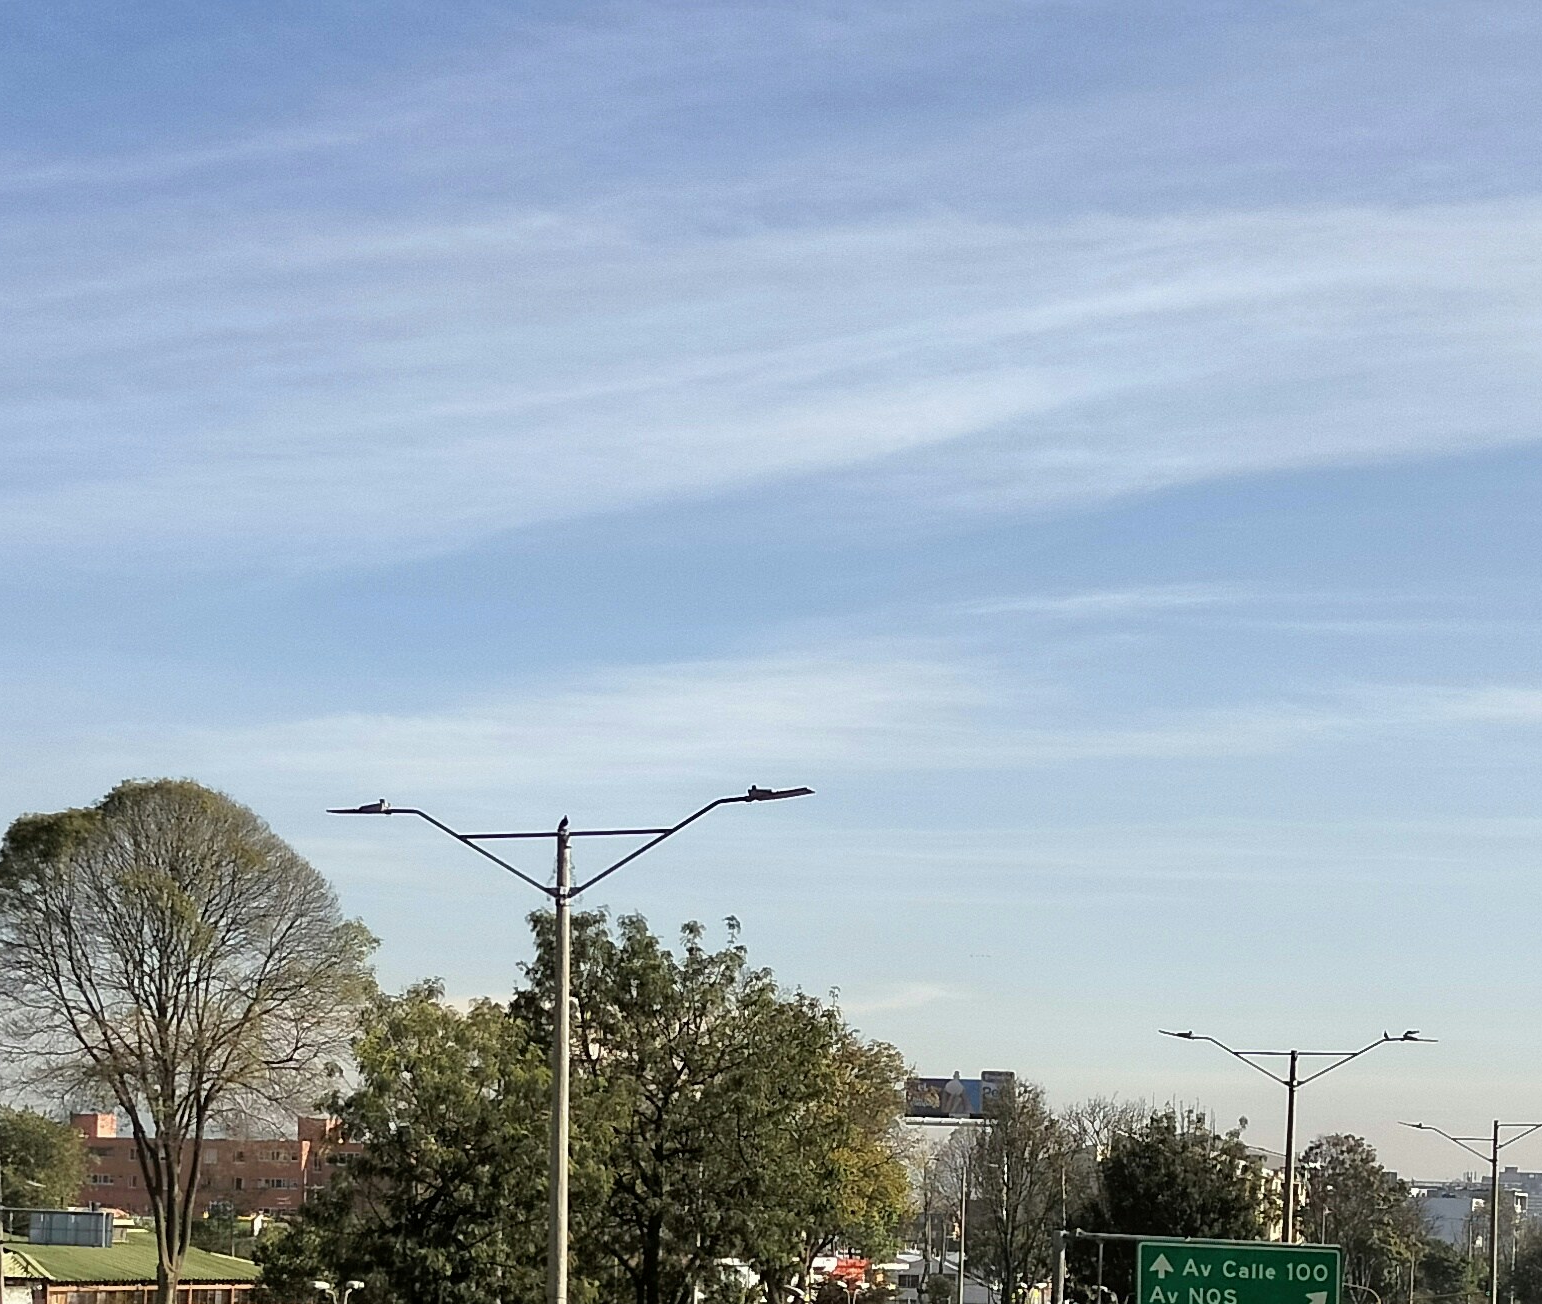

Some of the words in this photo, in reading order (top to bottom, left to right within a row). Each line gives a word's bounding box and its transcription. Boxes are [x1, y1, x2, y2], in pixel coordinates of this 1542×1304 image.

[1182, 1258, 1212, 1277] Av
[1222, 1260, 1276, 1280] Calle
[1286, 1262, 1329, 1282] 100
[1149, 1285, 1179, 1304] Av
